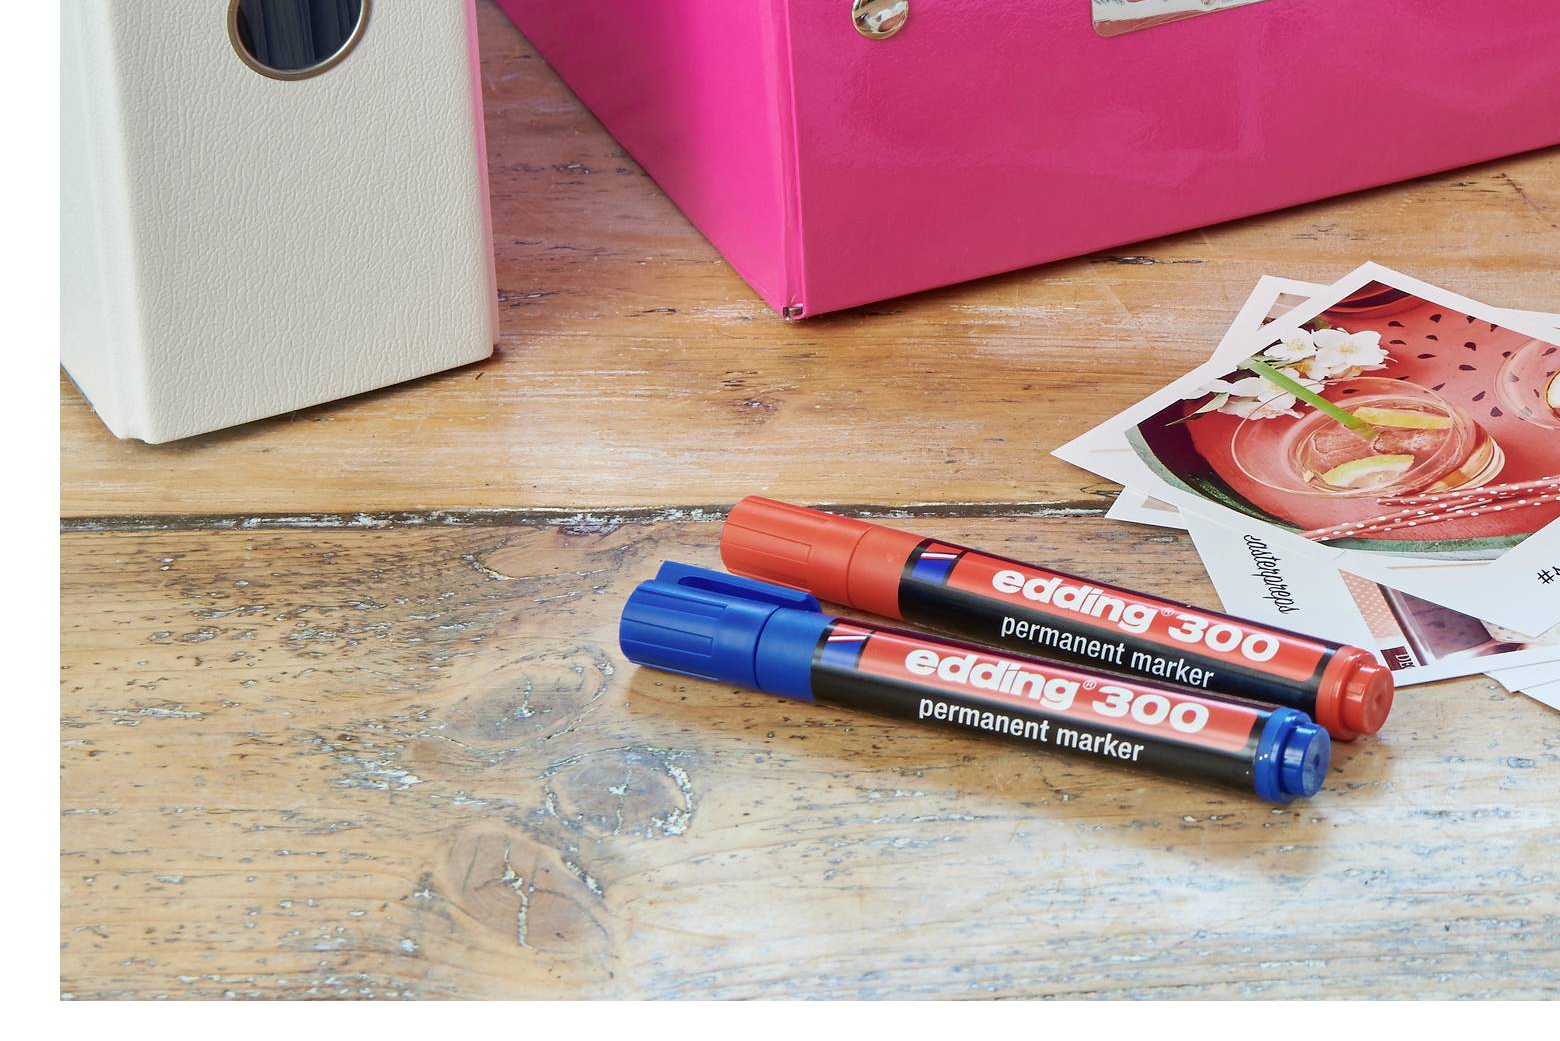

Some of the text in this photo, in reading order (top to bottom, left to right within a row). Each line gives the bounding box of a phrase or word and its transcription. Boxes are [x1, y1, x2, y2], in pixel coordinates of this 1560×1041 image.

[1000, 614, 1214, 689] permanent marker
[1168, 615, 1280, 663] 300
[917, 696, 1144, 762] permanent marker
[1092, 692, 1210, 734] 300
